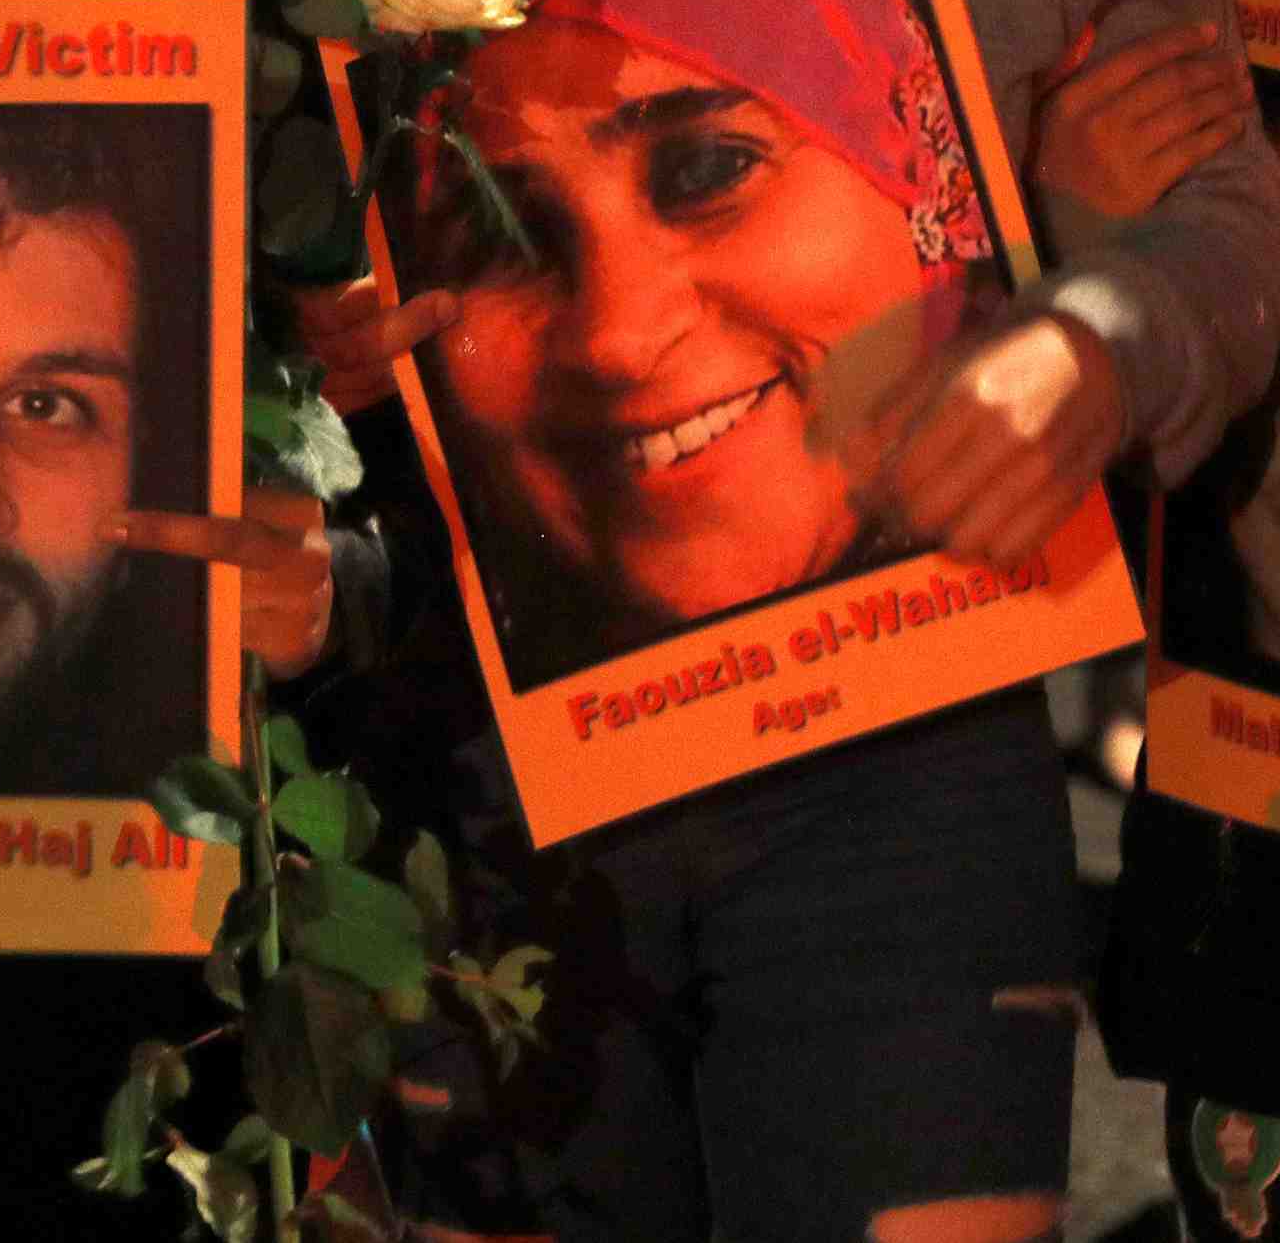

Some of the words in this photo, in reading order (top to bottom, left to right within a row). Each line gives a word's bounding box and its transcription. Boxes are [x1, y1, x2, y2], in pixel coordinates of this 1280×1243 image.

[566, 638, 778, 740] Faouzia
[752, 685, 843, 735] Age:
[111, 821, 189, 869] Ali
